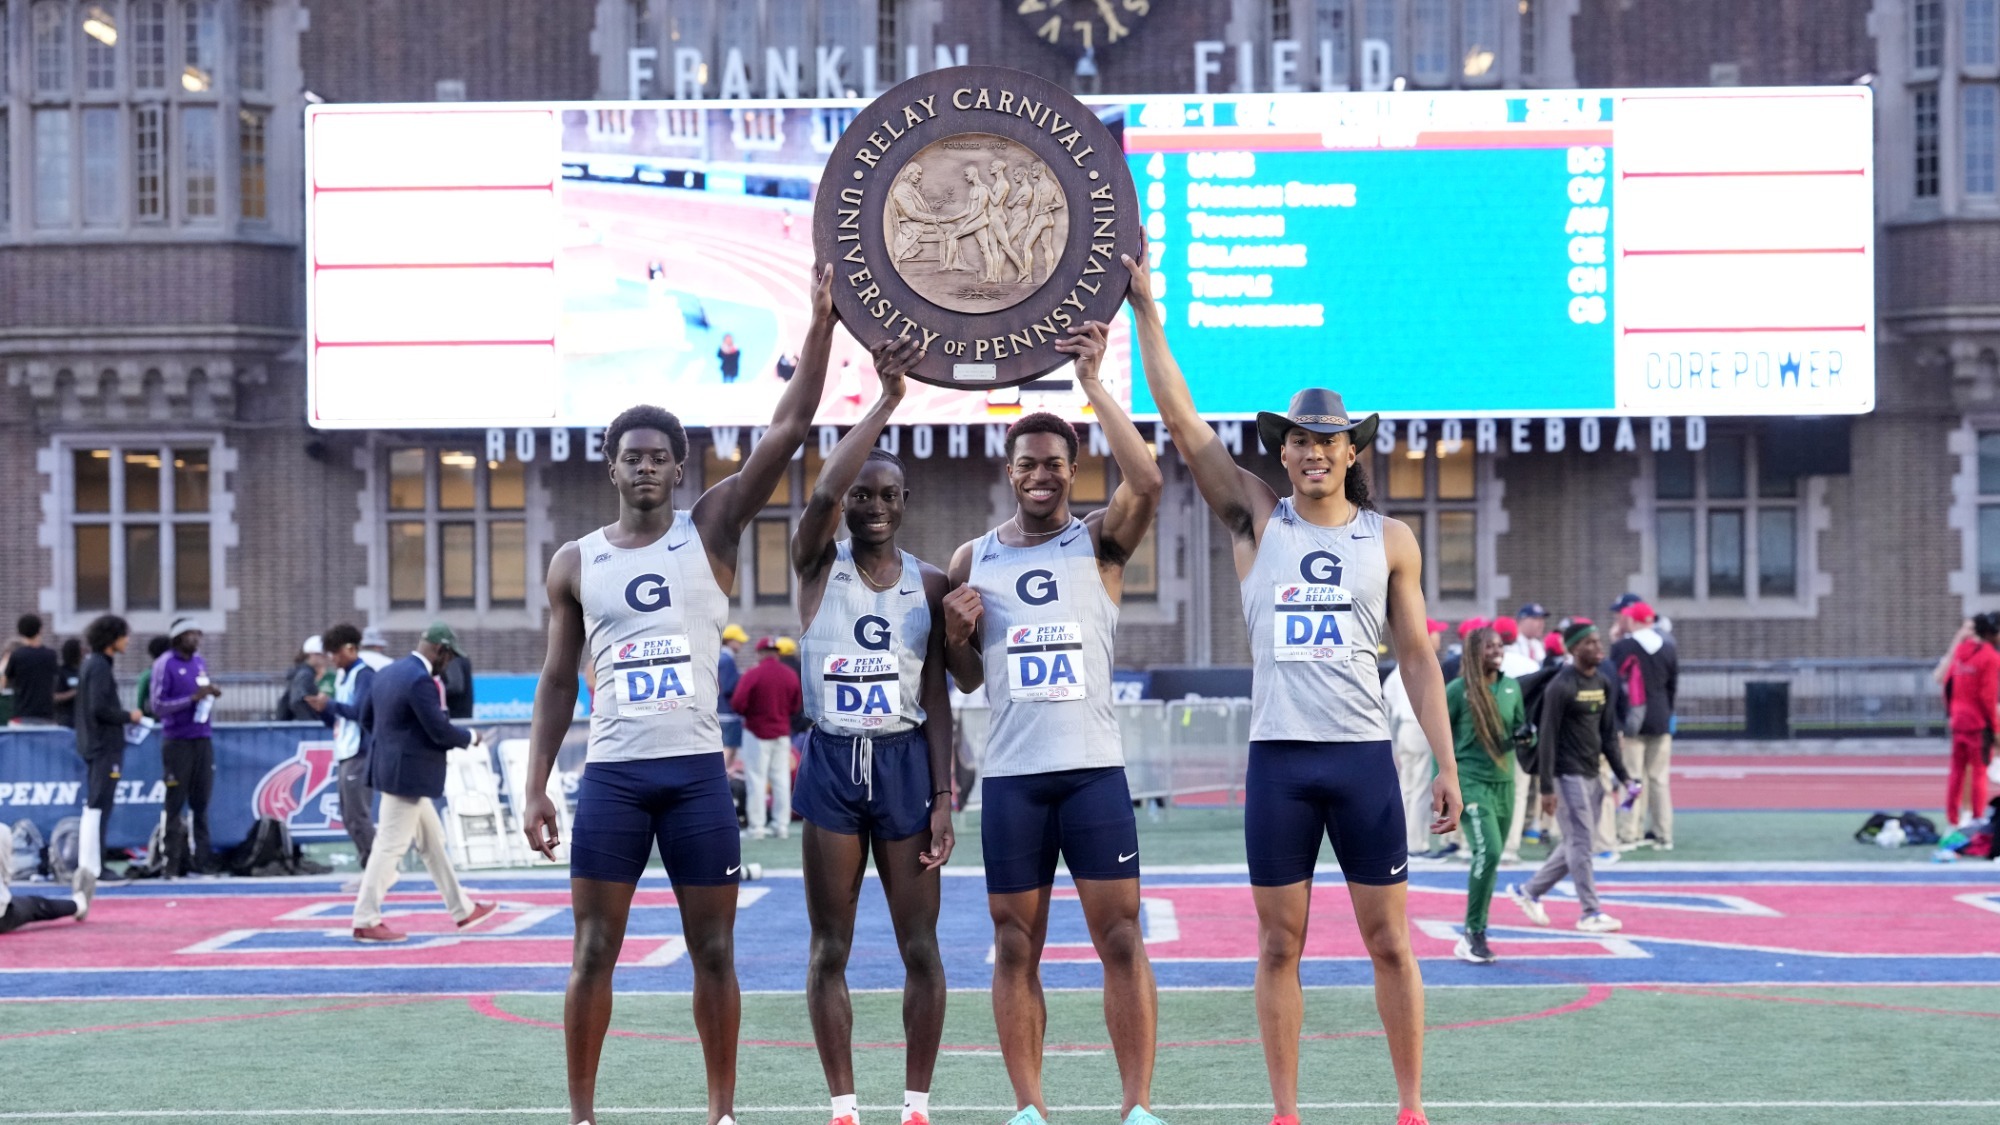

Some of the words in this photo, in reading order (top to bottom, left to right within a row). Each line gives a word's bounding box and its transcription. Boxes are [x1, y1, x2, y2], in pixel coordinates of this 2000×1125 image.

[1193, 38, 1391, 93] FIELD
[854, 94, 938, 169] RELAY
[952, 87, 1095, 168] CARNIVAL
[943, 142, 981, 150] FOUNDED
[837, 187, 941, 351] UNIVERSITY
[944, 339, 967, 357] OF
[974, 182, 1116, 361] PENNSYLVANIA
[1647, 352, 1722, 389] CORE
[1734, 350, 1843, 388] POWER
[486, 427, 605, 461] ROBE
[879, 425, 1112, 458] JOHNN
[1375, 417, 1708, 454] SCOREBOARD
[1300, 550, 1343, 586] G
[625, 573, 671, 612] G
[1016, 569, 1060, 606] G
[1305, 594, 1344, 602] RELAYS
[854, 614, 892, 651] G
[1036, 633, 1075, 643] RELAYS
[1037, 625, 1066, 634] PENN
[1286, 614, 1344, 645] DA
[642, 645, 682, 657] RELAYS
[643, 639, 672, 649] PENN
[1312, 648, 1334, 658] 250
[853, 663, 892, 673] RELAYS
[855, 657, 883, 666] PENN
[1020, 653, 1078, 687] DA
[627, 667, 687, 702] DA
[1049, 686, 1069, 698] 250
[657, 700, 679, 711] 250
[836, 684, 892, 715] DA
[861, 717, 883, 727] 250
[0, 781, 82, 806] PENN
[113, 780, 168, 804] ELA
